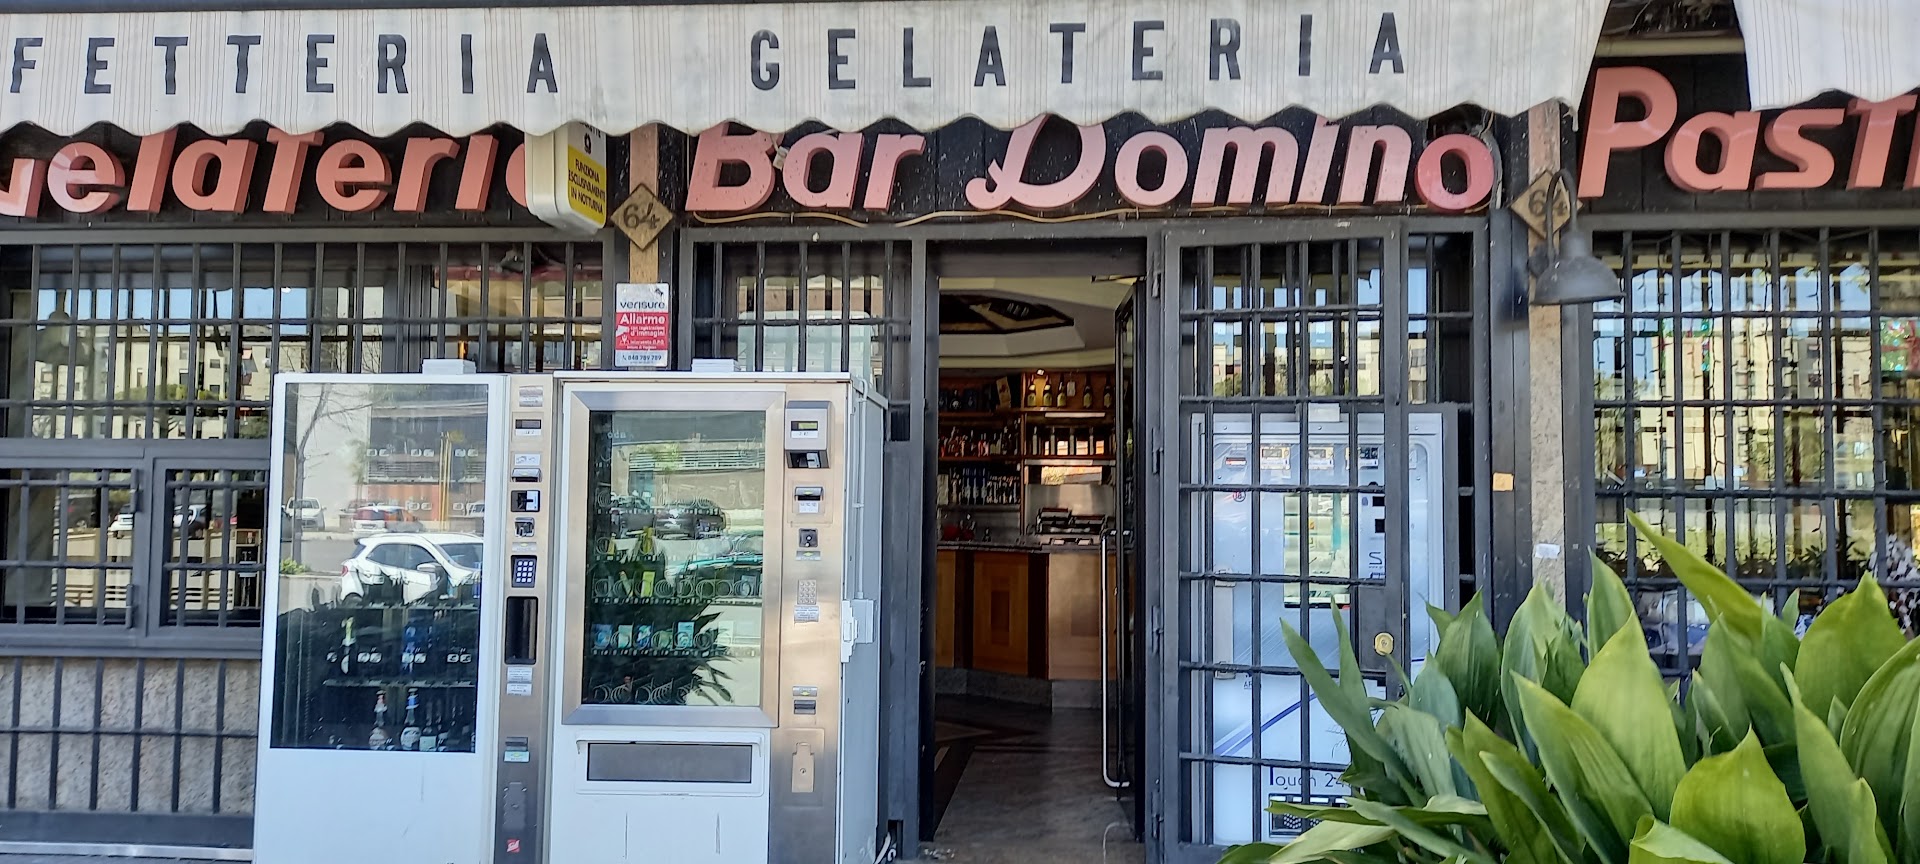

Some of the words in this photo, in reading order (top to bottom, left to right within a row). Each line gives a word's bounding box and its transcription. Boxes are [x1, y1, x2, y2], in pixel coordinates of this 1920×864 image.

[10, 33, 559, 95] FETTERIA
[750, 12, 1404, 91] GELATERIA
[574, 158, 600, 184] FUNZIONA
[685, 122, 926, 212] Bar
[965, 112, 1497, 211] Domino
[577, 190, 604, 214] NOTTURNA
[623, 202, 660, 229] 64
[620, 301, 666, 309] verisure
[620, 313, 666, 325] Allarme
